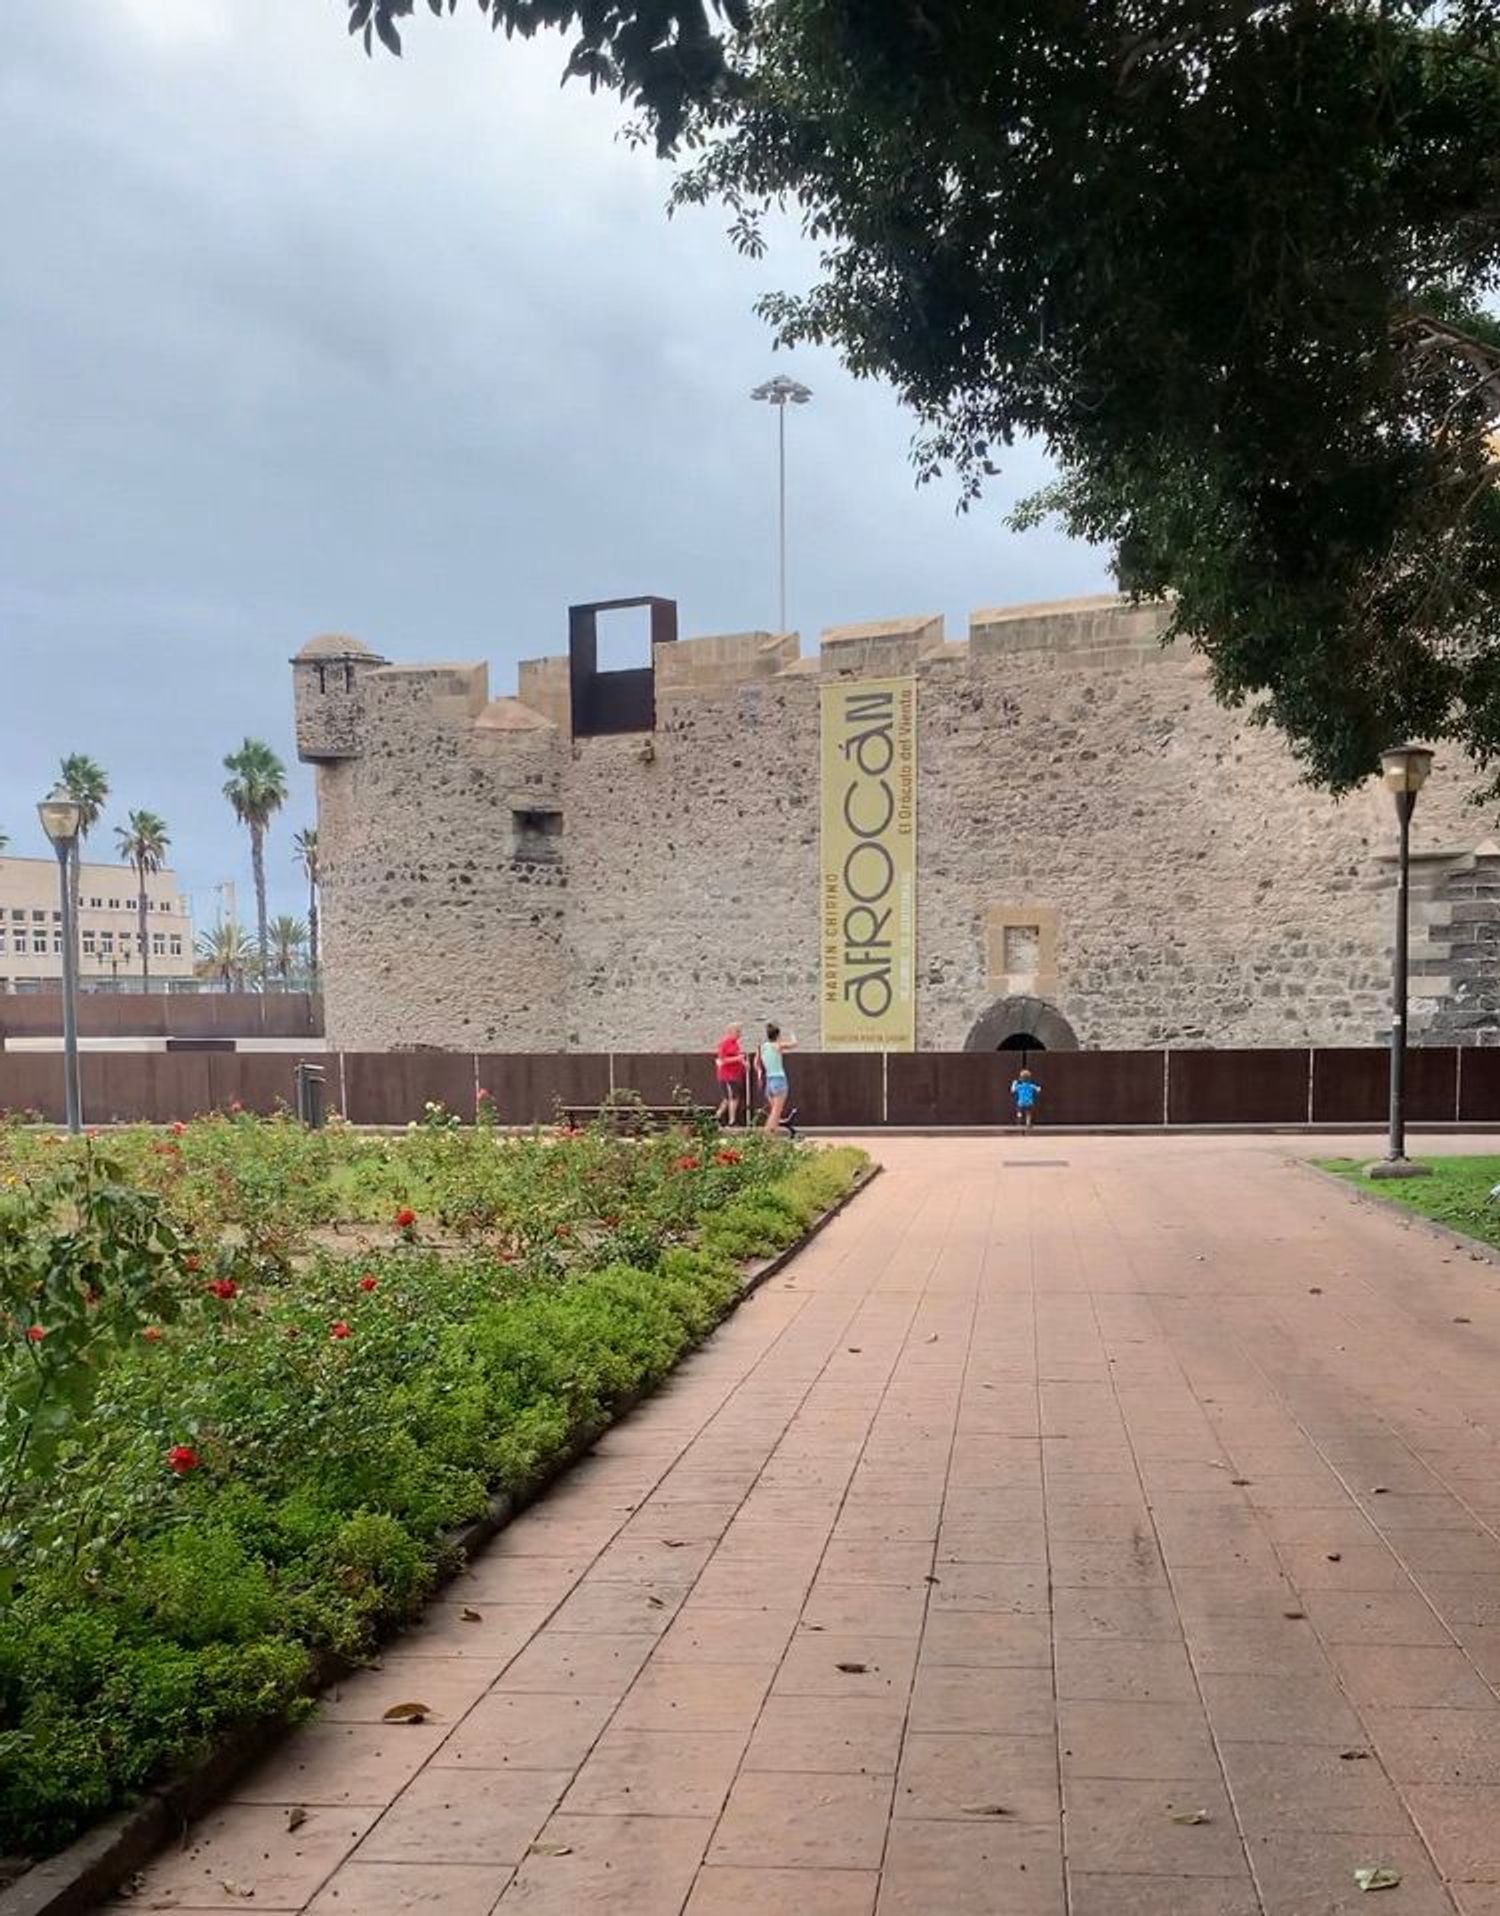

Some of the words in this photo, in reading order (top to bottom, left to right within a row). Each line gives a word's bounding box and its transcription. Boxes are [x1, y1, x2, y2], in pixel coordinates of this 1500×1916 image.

[898, 690, 912, 735] Viento
[898, 739, 912, 761] del
[898, 824, 912, 835] El
[825, 874, 838, 937] CHIRINO
